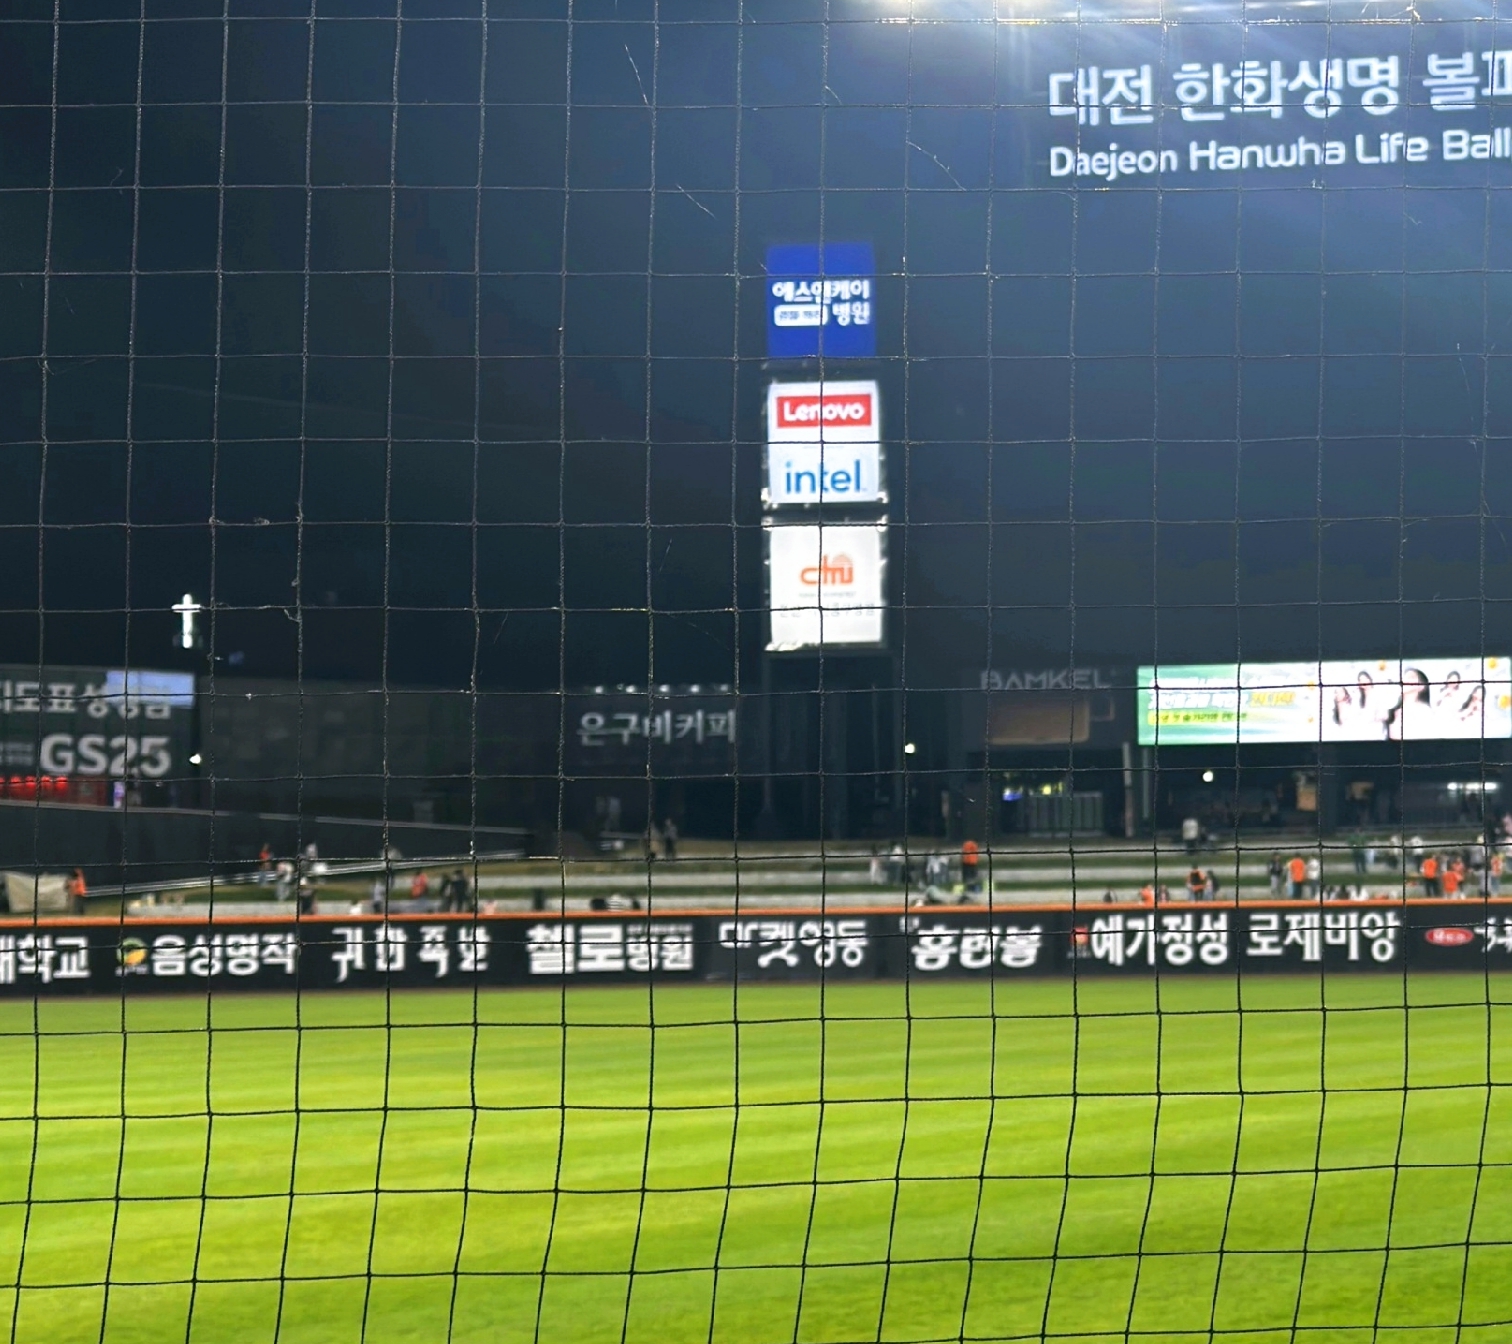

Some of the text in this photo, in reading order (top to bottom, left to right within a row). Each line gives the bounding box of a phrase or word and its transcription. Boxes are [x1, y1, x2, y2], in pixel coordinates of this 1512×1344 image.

[1048, 64, 1154, 126] 대전
[1172, 55, 1401, 122] 한화생명
[1049, 146, 1178, 182] Daejeon
[1188, 136, 1347, 172] Hanwha
[1355, 131, 1430, 164] Life
[832, 301, 871, 327] 병원
[783, 400, 866, 423] Lenovo
[784, 459, 863, 494] intel
[576, 709, 737, 747] 은구비커피
[40, 733, 172, 778] GS25
[151, 933, 300, 977] 음성명작
[718, 920, 869, 969] 마켓영동
[1246, 911, 1402, 963] 로제비앙
